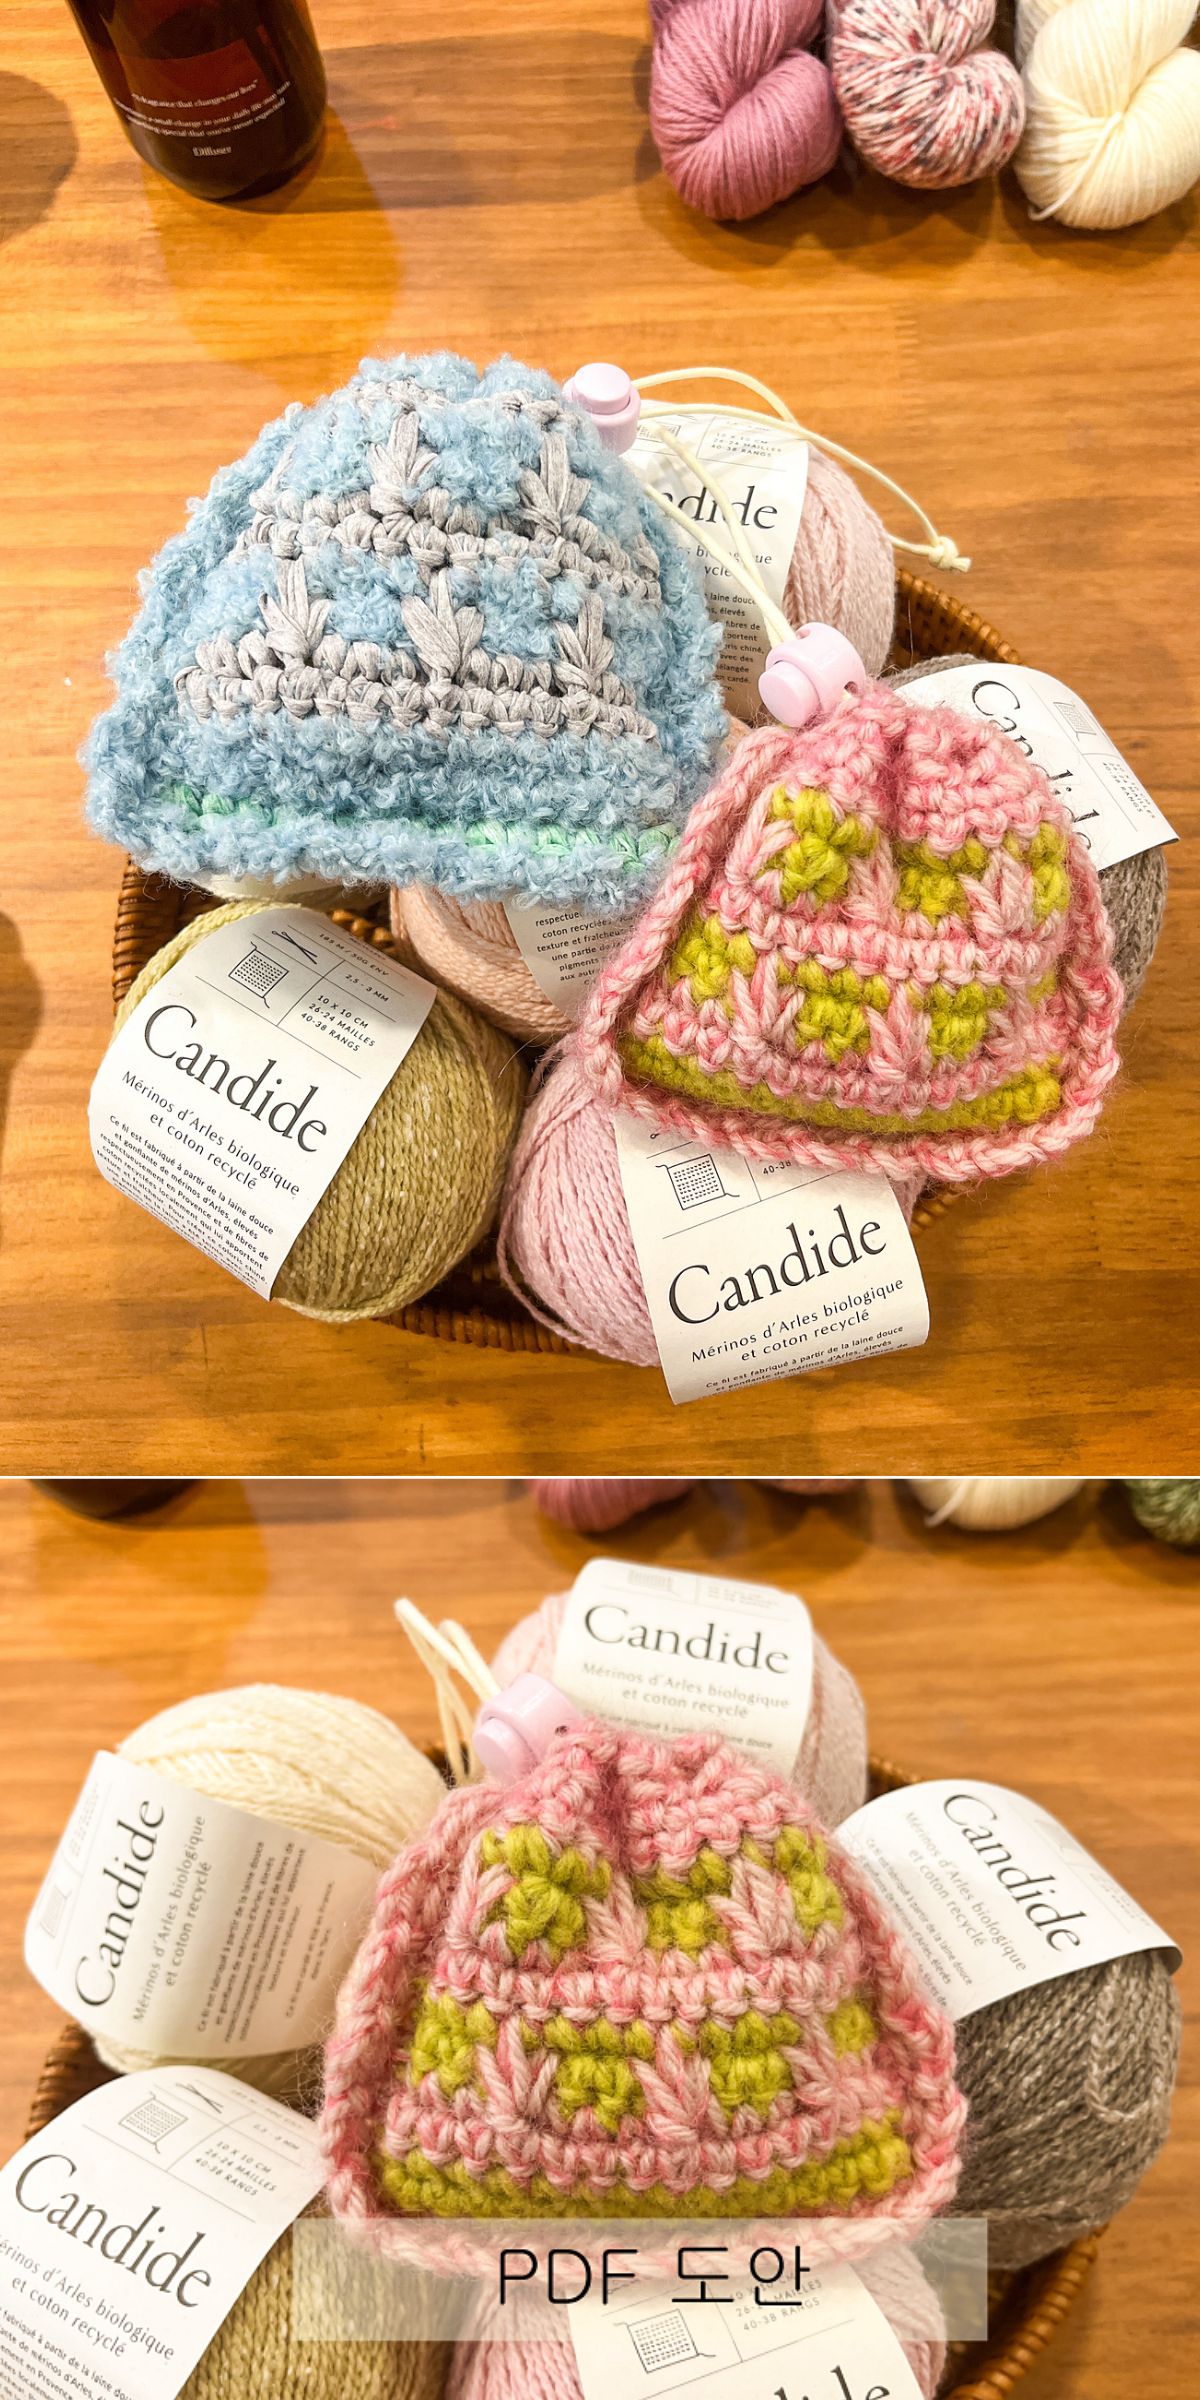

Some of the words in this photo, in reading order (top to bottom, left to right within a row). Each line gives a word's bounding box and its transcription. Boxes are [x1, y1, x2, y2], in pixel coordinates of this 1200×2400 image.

[710, 592, 730, 601] laine
[719, 606, 746, 617] élevés
[750, 623, 760, 631] de
[535, 911, 582, 927] respectue
[537, 941, 569, 952] texture
[572, 937, 581, 945] et
[542, 928, 568, 938] coton
[552, 953, 568, 961] une
[559, 958, 599, 972] pigments
[318, 995, 329, 1004] 10
[340, 1009, 352, 1018] 10
[354, 1017, 368, 1029] CM
[373, 991, 389, 1002] MM
[301, 1013, 327, 1031] 40-38
[329, 1029, 360, 1051] RANGS
[309, 1003, 335, 1022] 26-24
[337, 1020, 375, 1046] MAILLES
[143, 1003, 328, 1153] Candide
[122, 1071, 174, 1113] Mérinos
[227, 1139, 299, 1195] biologique
[150, 1114, 163, 1127] et
[167, 1126, 204, 1155] coton
[207, 1153, 257, 1189] recyclé
[110, 1115, 120, 1126] Ce
[130, 1132, 142, 1143] est
[144, 1140, 175, 1166] fabriqué
[177, 1163, 182, 1171] à
[183, 1169, 205, 1186] partir
[206, 1185, 217, 1195] de
[218, 1192, 226, 1202] la
[227, 1198, 247, 1216] laine
[249, 1215, 273, 1234] douce
[114, 1133, 122, 1141] et
[160, 1166, 169, 1175] de
[171, 1174, 200, 1198] mérinos
[233, 1218, 258, 1240] élevés
[166, 1183, 175, 1192] en
[178, 1190, 211, 1219] Provence
[213, 1218, 221, 1227] et
[223, 1226, 233, 1235] de
[235, 1233, 256, 1253] fibres
[258, 1252, 269, 1261] de
[668, 1204, 887, 1324] Candide
[692, 1334, 757, 1362] Mérinos
[823, 1278, 904, 1317] biologique
[741, 1349, 756, 1361] et
[763, 1334, 807, 1354] coton
[814, 1309, 869, 1338] recyclé
[750, 1361, 788, 1376] fabriqué
[800, 1351, 824, 1363] partir
[852, 1336, 873, 1347] laine
[876, 1326, 903, 1339] douce
[584, 1604, 790, 1675] Candide
[622, 1689, 637, 1699] et
[642, 1693, 687, 1708] coton
[708, 1684, 790, 1709] biologique
[943, 1794, 1087, 1953] Candide
[74, 1800, 165, 2008] Candide
[132, 1963, 161, 2021] Mérinos
[169, 1816, 205, 1899] biologique
[166, 1971, 178, 1986] et
[172, 1922, 193, 1967] coton
[186, 1862, 212, 1918] recyclé
[920, 1865, 950, 1899] coton
[946, 1901, 987, 1946] recyclé
[971, 1902, 1026, 1970] biologique
[224, 2174, 258, 2196] RANGS
[235, 2165, 277, 2191] MAILLES
[15, 2153, 212, 2309] Candide
[0, 2236, 41, 2273] érinos
[95, 2299, 174, 2360] biologique
[12, 2278, 27, 2293] et
[30, 2289, 69, 2321] coton
[71, 2317, 126, 2357] recyclé
[743, 2313, 777, 2331] 40-38
[68, 2357, 80, 2369] de
